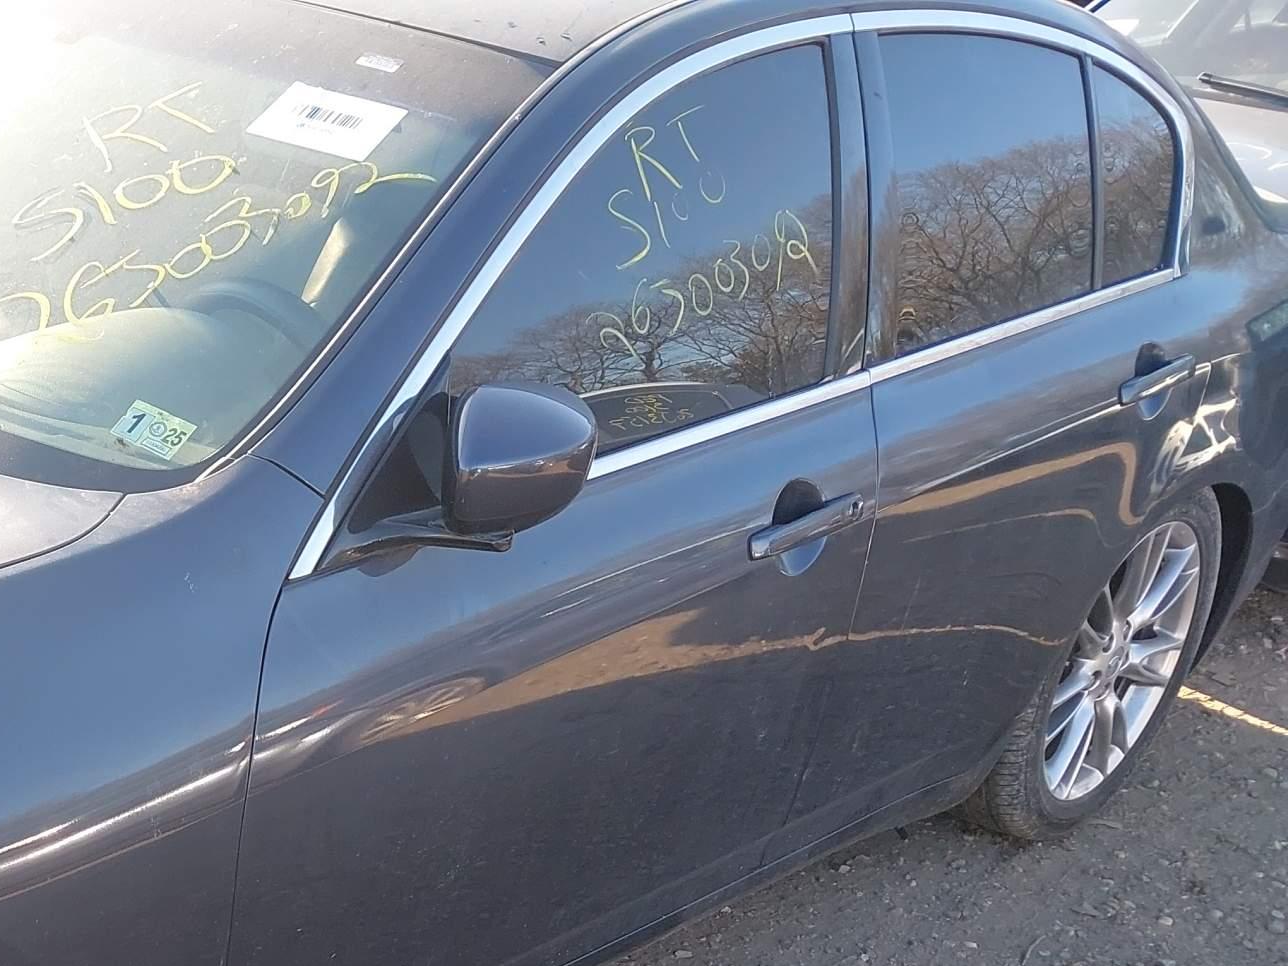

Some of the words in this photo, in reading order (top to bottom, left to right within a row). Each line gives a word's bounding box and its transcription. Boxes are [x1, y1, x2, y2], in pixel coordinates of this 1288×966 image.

[83, 81, 216, 172] RT
[625, 105, 705, 201] RT
[127, 413, 146, 434] 1
[160, 428, 188, 447] 25
